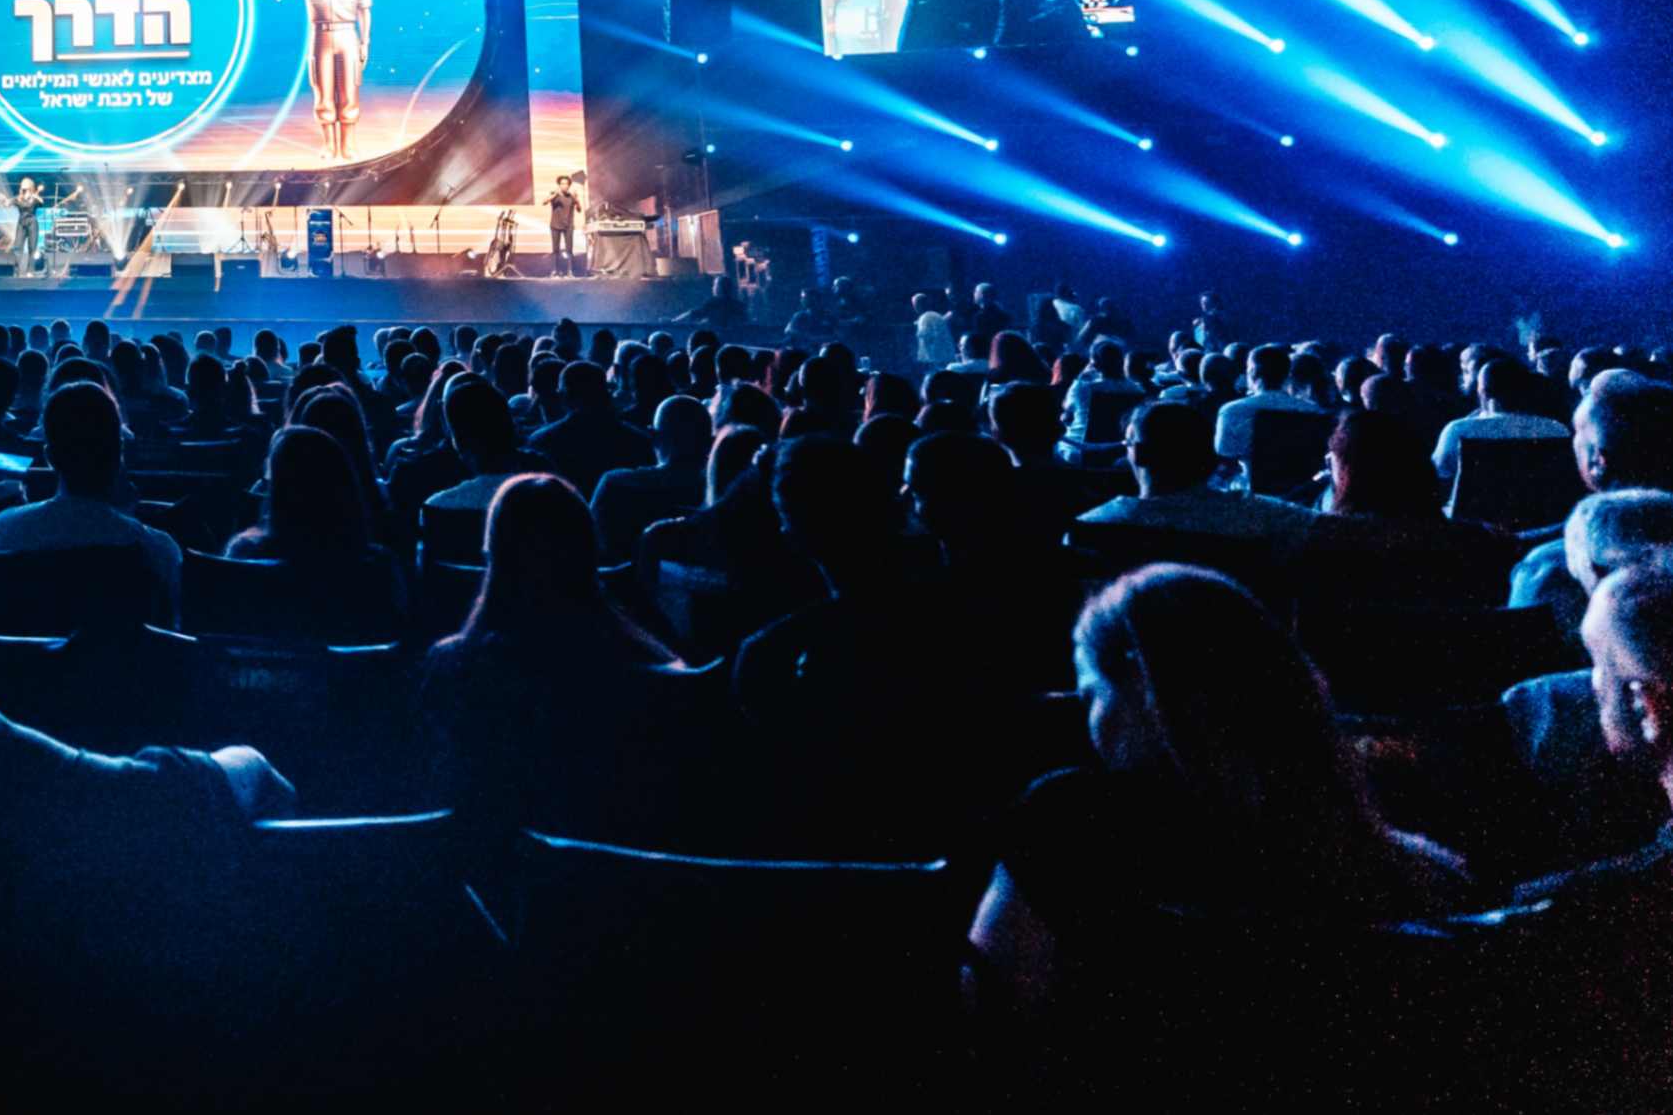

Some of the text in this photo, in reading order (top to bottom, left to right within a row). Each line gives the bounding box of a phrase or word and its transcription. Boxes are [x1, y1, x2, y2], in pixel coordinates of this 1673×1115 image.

[1, 68, 212, 89] מצדיעים לאנשי המילואים
[39, 89, 173, 108] של רכבת ישראל
